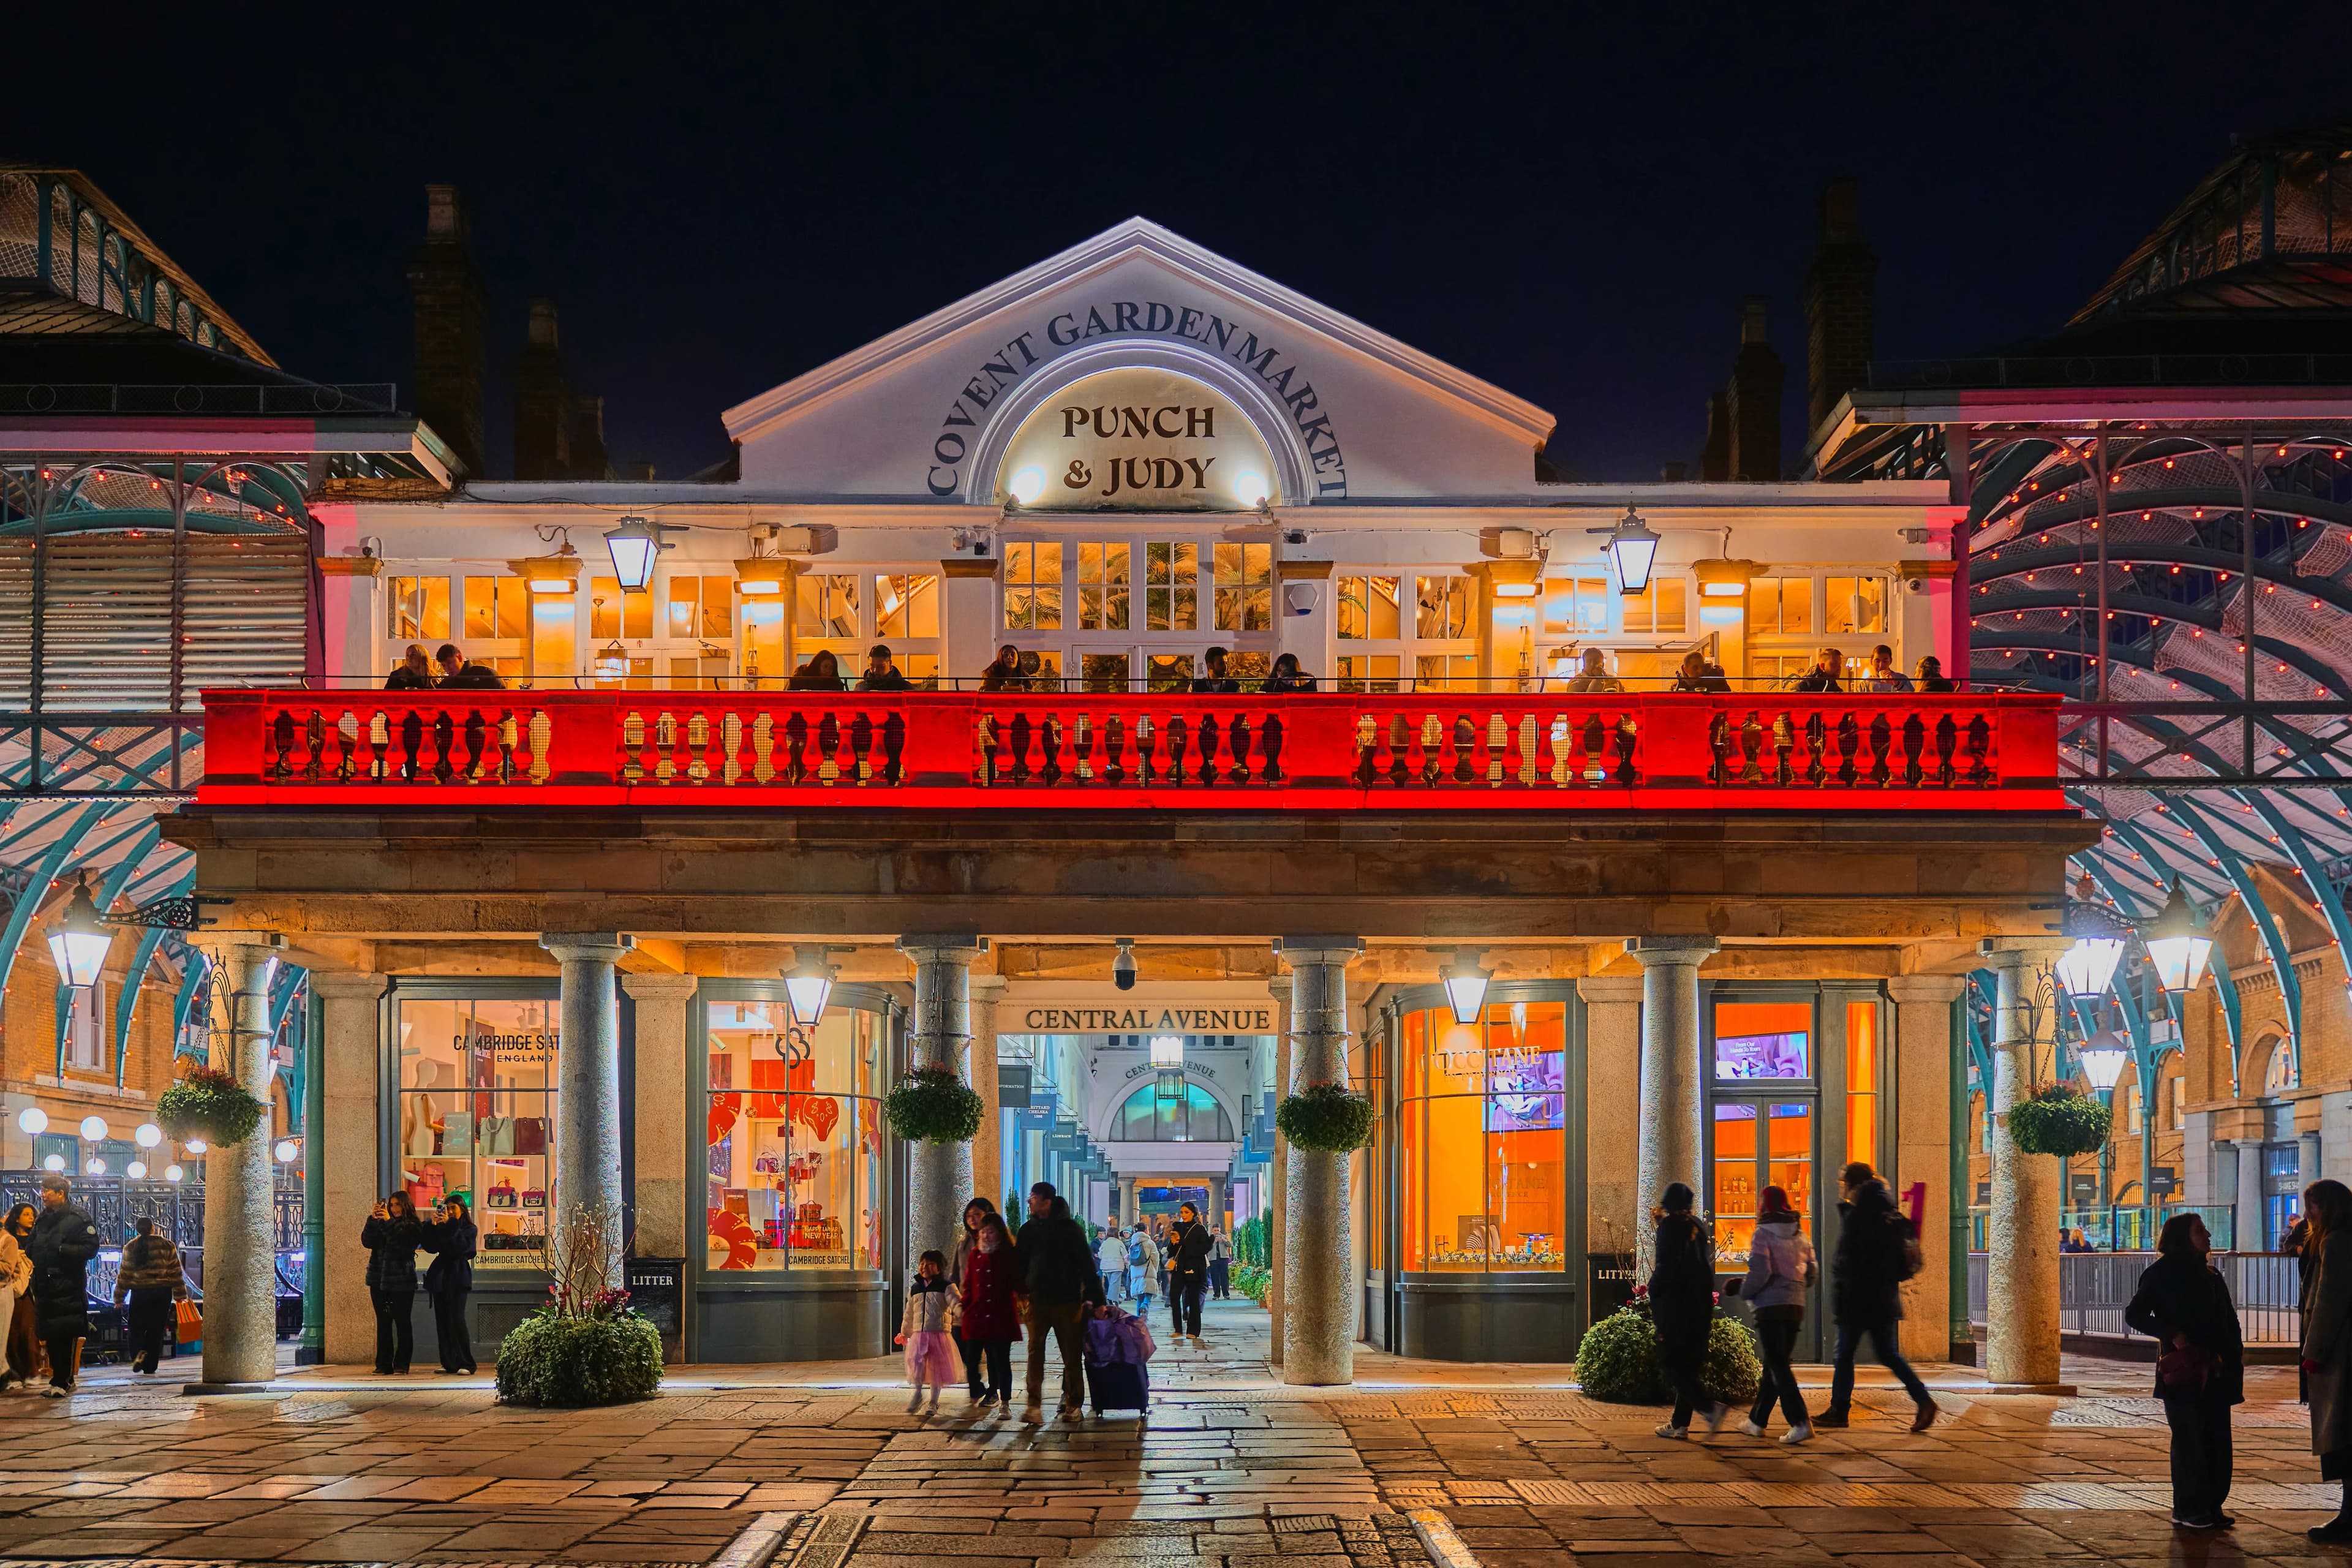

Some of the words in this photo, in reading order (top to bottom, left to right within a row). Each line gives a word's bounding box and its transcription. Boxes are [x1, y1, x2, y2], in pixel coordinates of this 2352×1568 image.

[927, 331, 1041, 497] COVENT
[1047, 301, 1238, 352] GARDEN
[1232, 331, 1347, 500] MARKET
[1060, 406, 1216, 439] PUNCH
[1063, 459, 1092, 489] &
[1101, 456, 1216, 497] JUDY
[1025, 1009, 1153, 1029] CENTRAL
[1158, 1009, 1270, 1029] AVENUE
[453, 1035, 532, 1050] CAMBRIDGE
[475, 1256, 514, 1264] CAMBRIDGE
[788, 1256, 826, 1264] CAMBRIDGE
[827, 1255, 850, 1264] SATCHEL
[632, 1276, 673, 1285] LITTER
